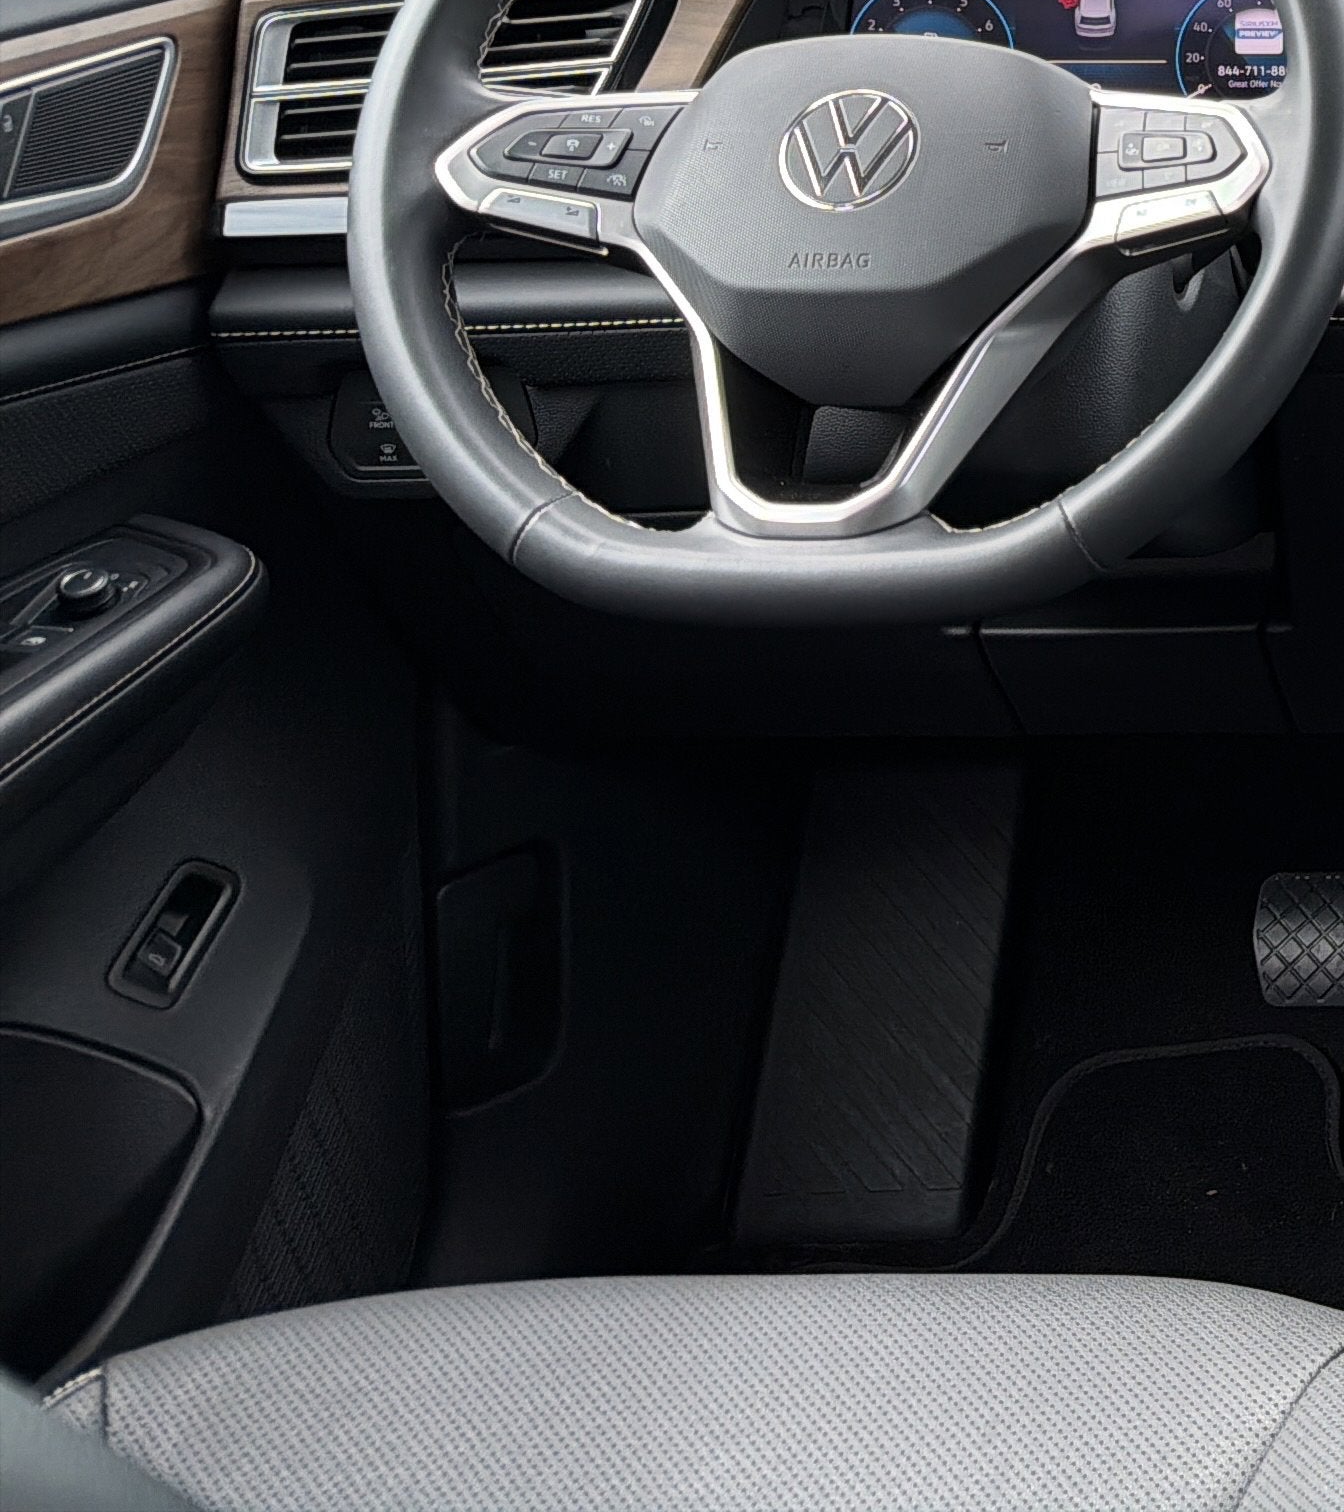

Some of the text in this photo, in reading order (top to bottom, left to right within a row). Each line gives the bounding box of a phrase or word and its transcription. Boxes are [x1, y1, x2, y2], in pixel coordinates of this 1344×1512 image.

[867, 19, 877, 31] 2
[984, 19, 994, 32] 6
[1193, 22, 1208, 33] 40
[1238, 30, 1278, 38] PREVIEW
[1185, 52, 1201, 64] 20
[1217, 65, 1288, 77] 844-711-88
[580, 114, 602, 124] RES
[547, 169, 569, 180] SET
[787, 252, 871, 269] AIRBAG
[368, 421, 394, 429] FRONT
